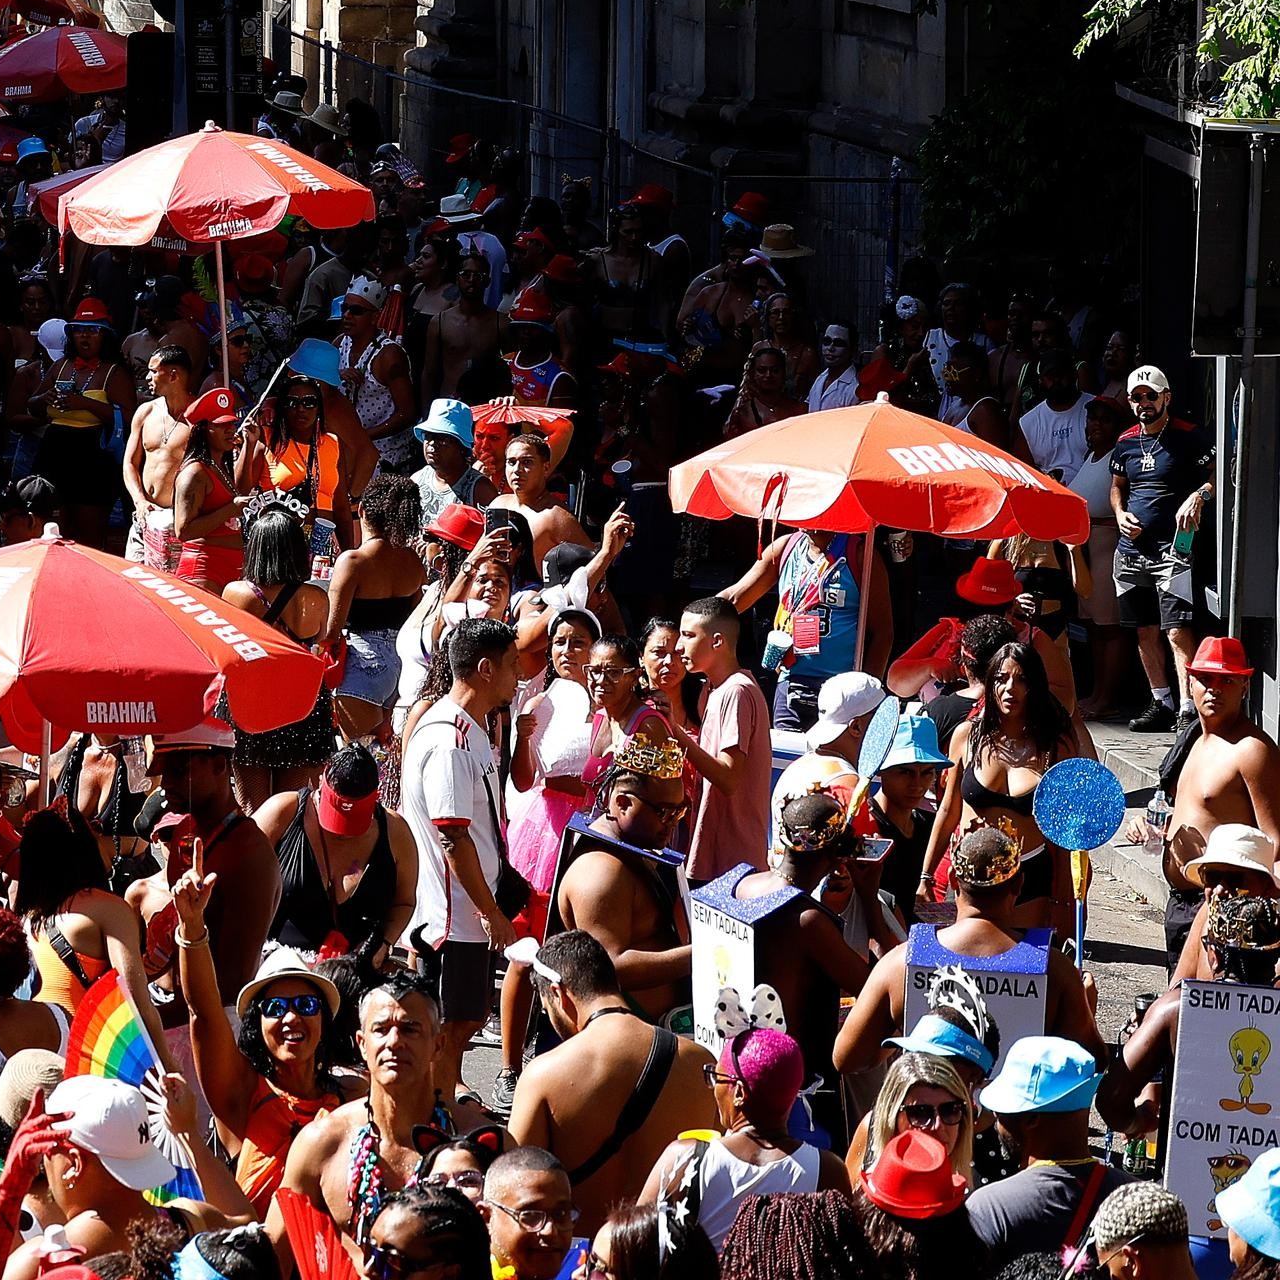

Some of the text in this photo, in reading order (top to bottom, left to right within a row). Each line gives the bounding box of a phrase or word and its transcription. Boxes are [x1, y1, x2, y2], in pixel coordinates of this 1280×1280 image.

[66, 32, 105, 67] BRAHMA
[4, 85, 32, 97] BRAHMA
[245, 141, 333, 192] BRAHMA
[208, 217, 253, 238] BRAHMA
[151, 236, 187, 251] BRAHMA
[1137, 371, 1151, 382] NY
[886, 442, 1049, 492] BRAHMA
[120, 563, 270, 662] BRAHMA
[86, 701, 156, 724] BRAHMA
[693, 903, 750, 944] SEM TADALA
[1188, 988, 1231, 1010] SEM
[696, 1024, 715, 1047] COM
[1175, 1119, 1221, 1142] COM
